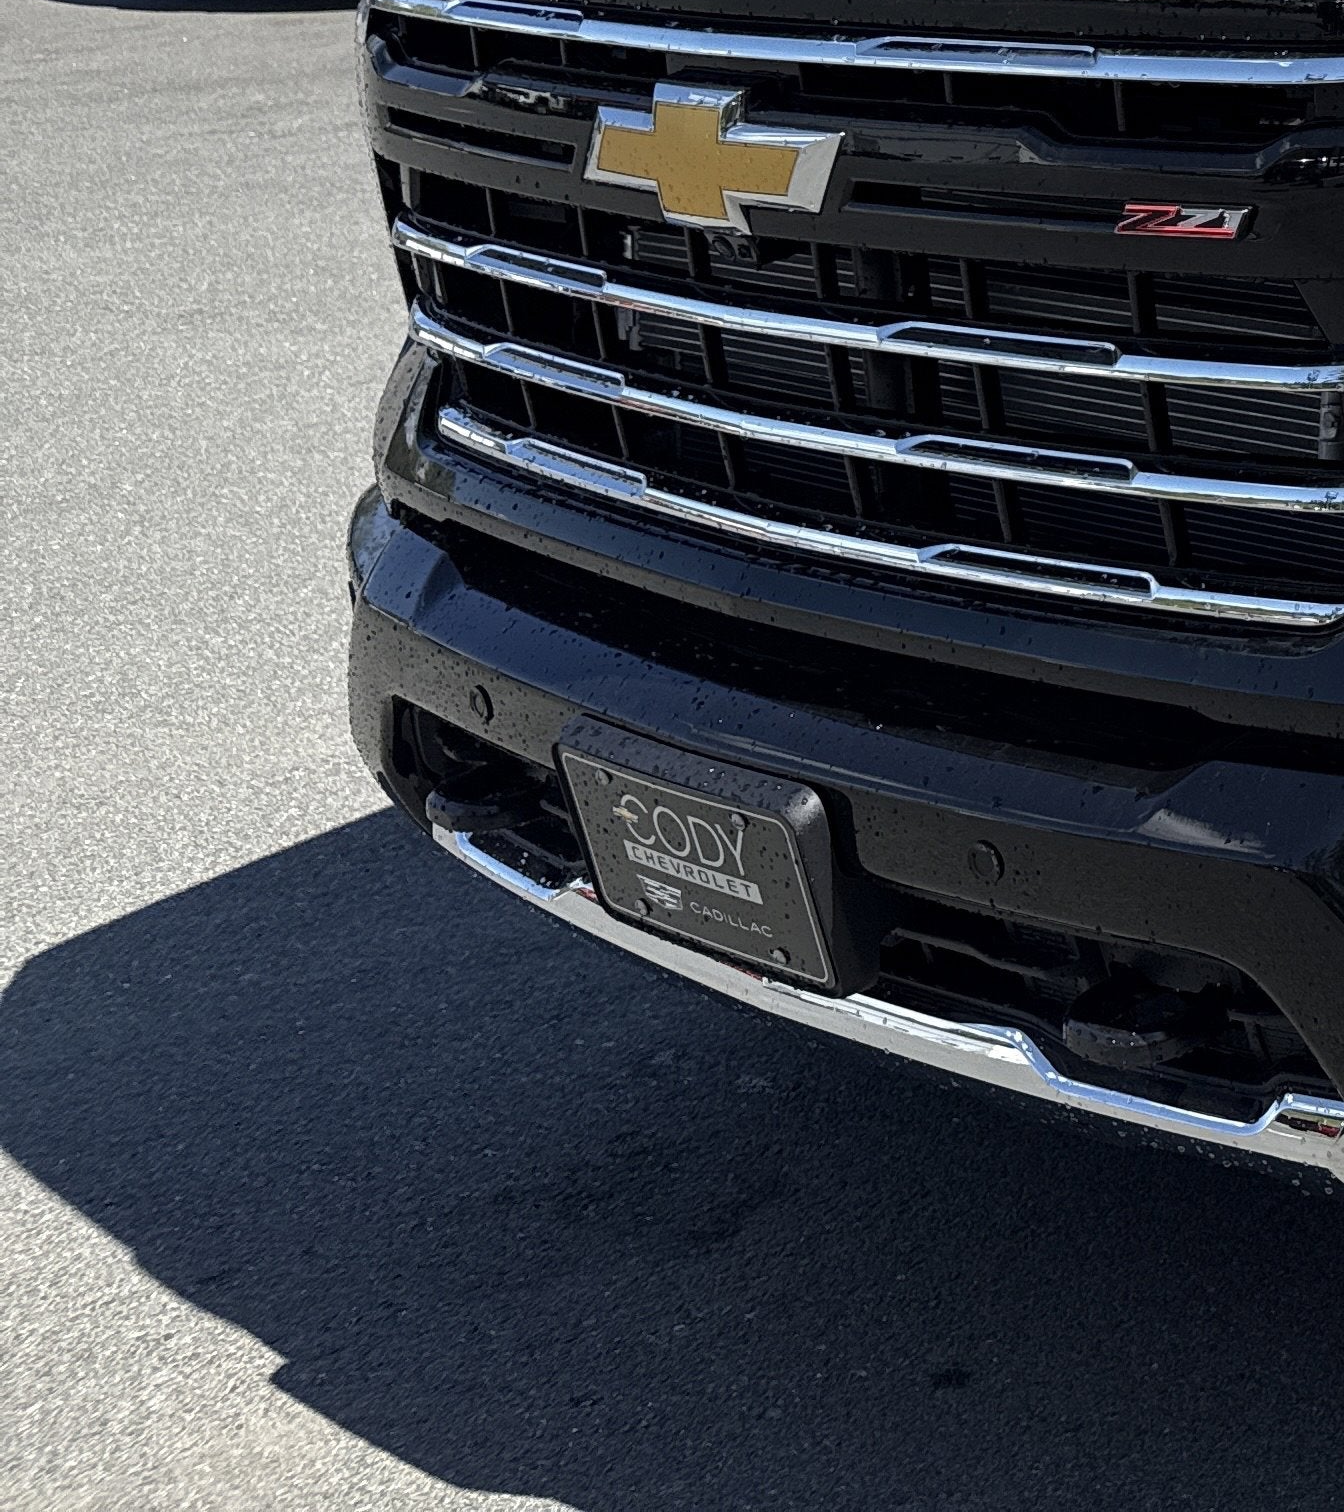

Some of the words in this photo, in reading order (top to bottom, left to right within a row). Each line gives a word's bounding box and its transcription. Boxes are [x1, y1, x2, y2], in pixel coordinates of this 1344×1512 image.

[1113, 203, 1252, 239] Z71
[616, 793, 745, 876] CODY
[632, 844, 752, 899] CHEVROLET
[690, 902, 773, 938] CADILLAC
